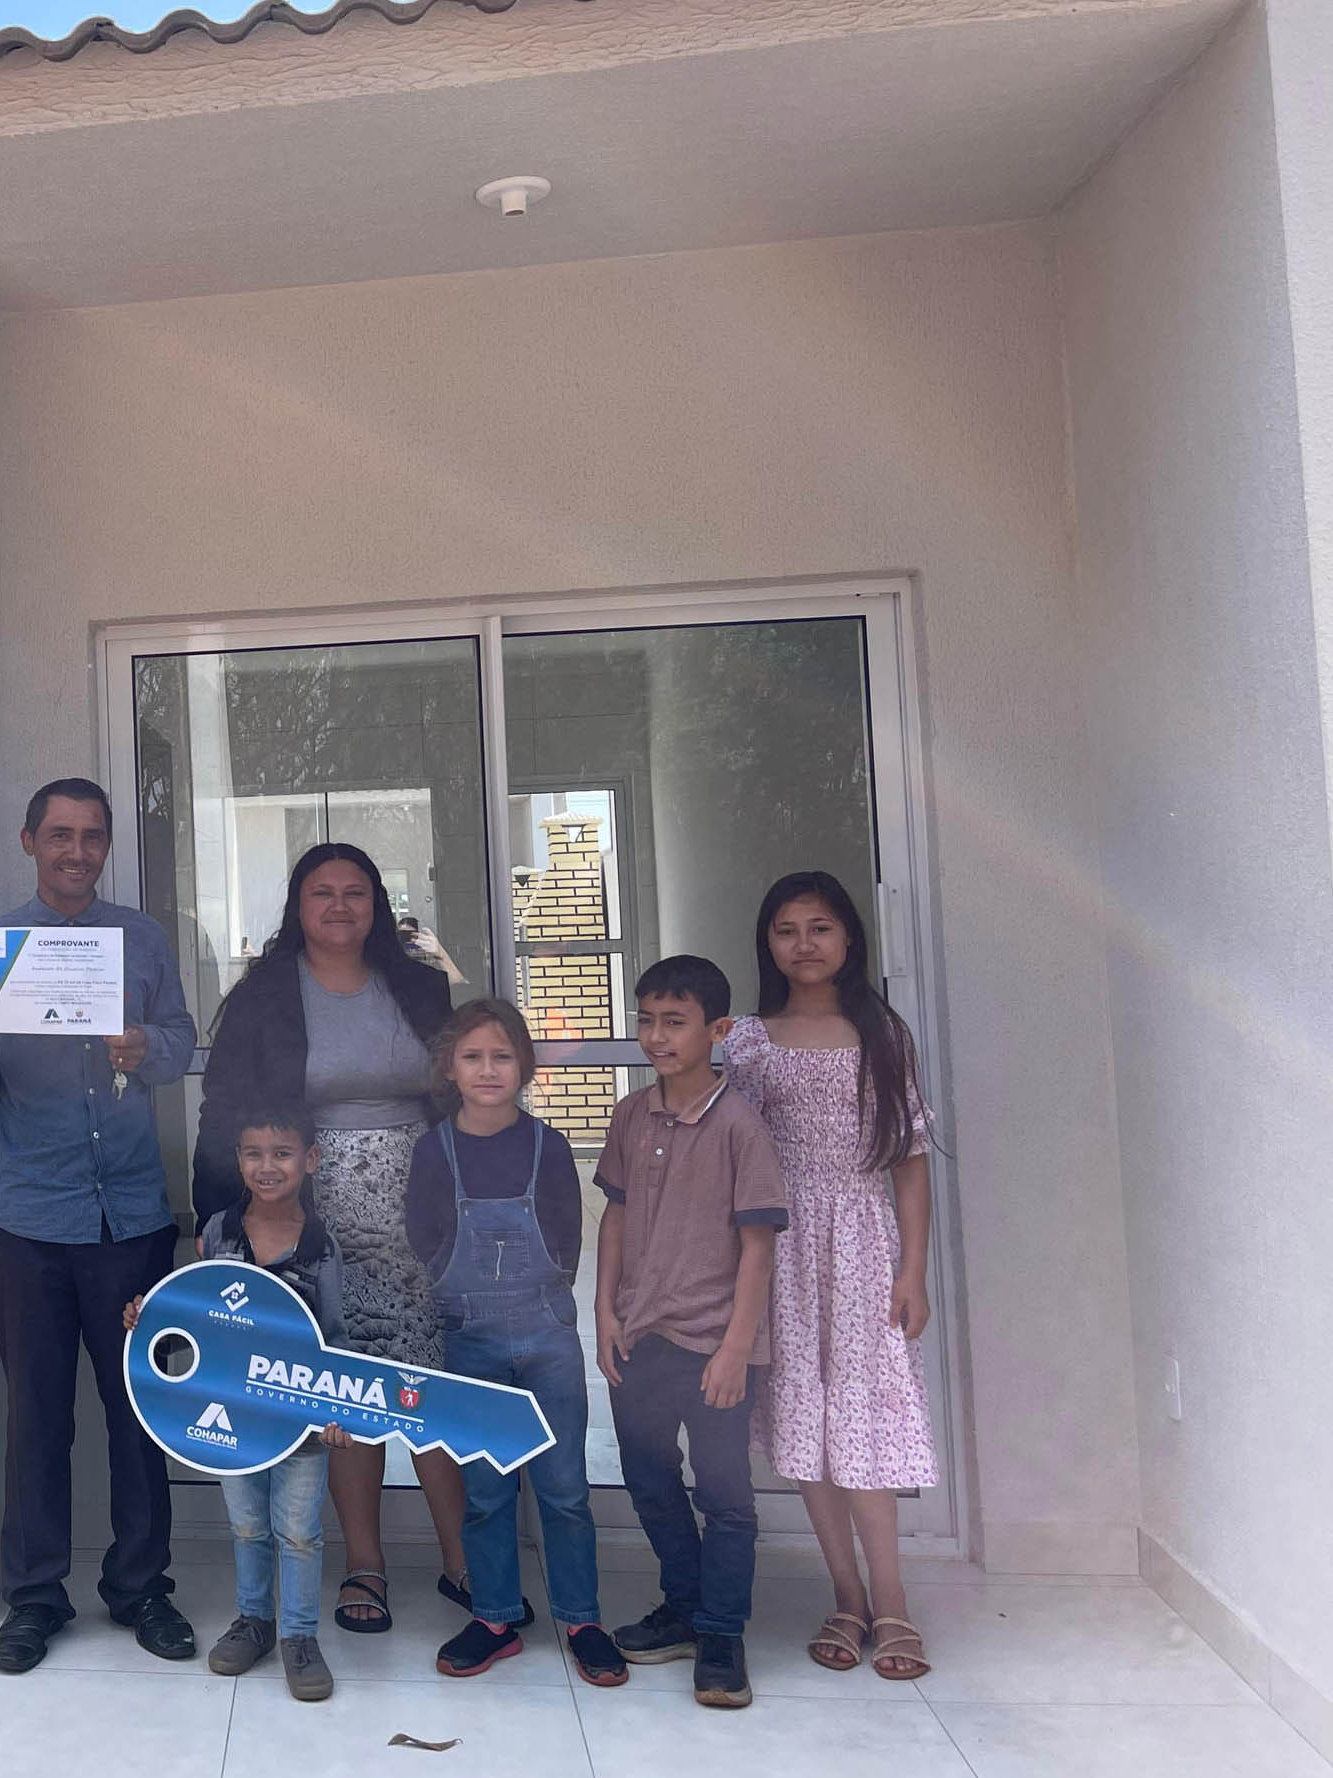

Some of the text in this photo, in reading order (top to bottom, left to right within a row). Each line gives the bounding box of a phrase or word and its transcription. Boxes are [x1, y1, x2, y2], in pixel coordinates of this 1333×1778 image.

[208, 1310, 230, 1321] CASA
[231, 1314, 255, 1326] FÁCIL
[247, 1354, 387, 1410] PARANÁ
[245, 1385, 424, 1433] GOVERNO DO ESTADO
[186, 1425, 238, 1446] COHAPAR
